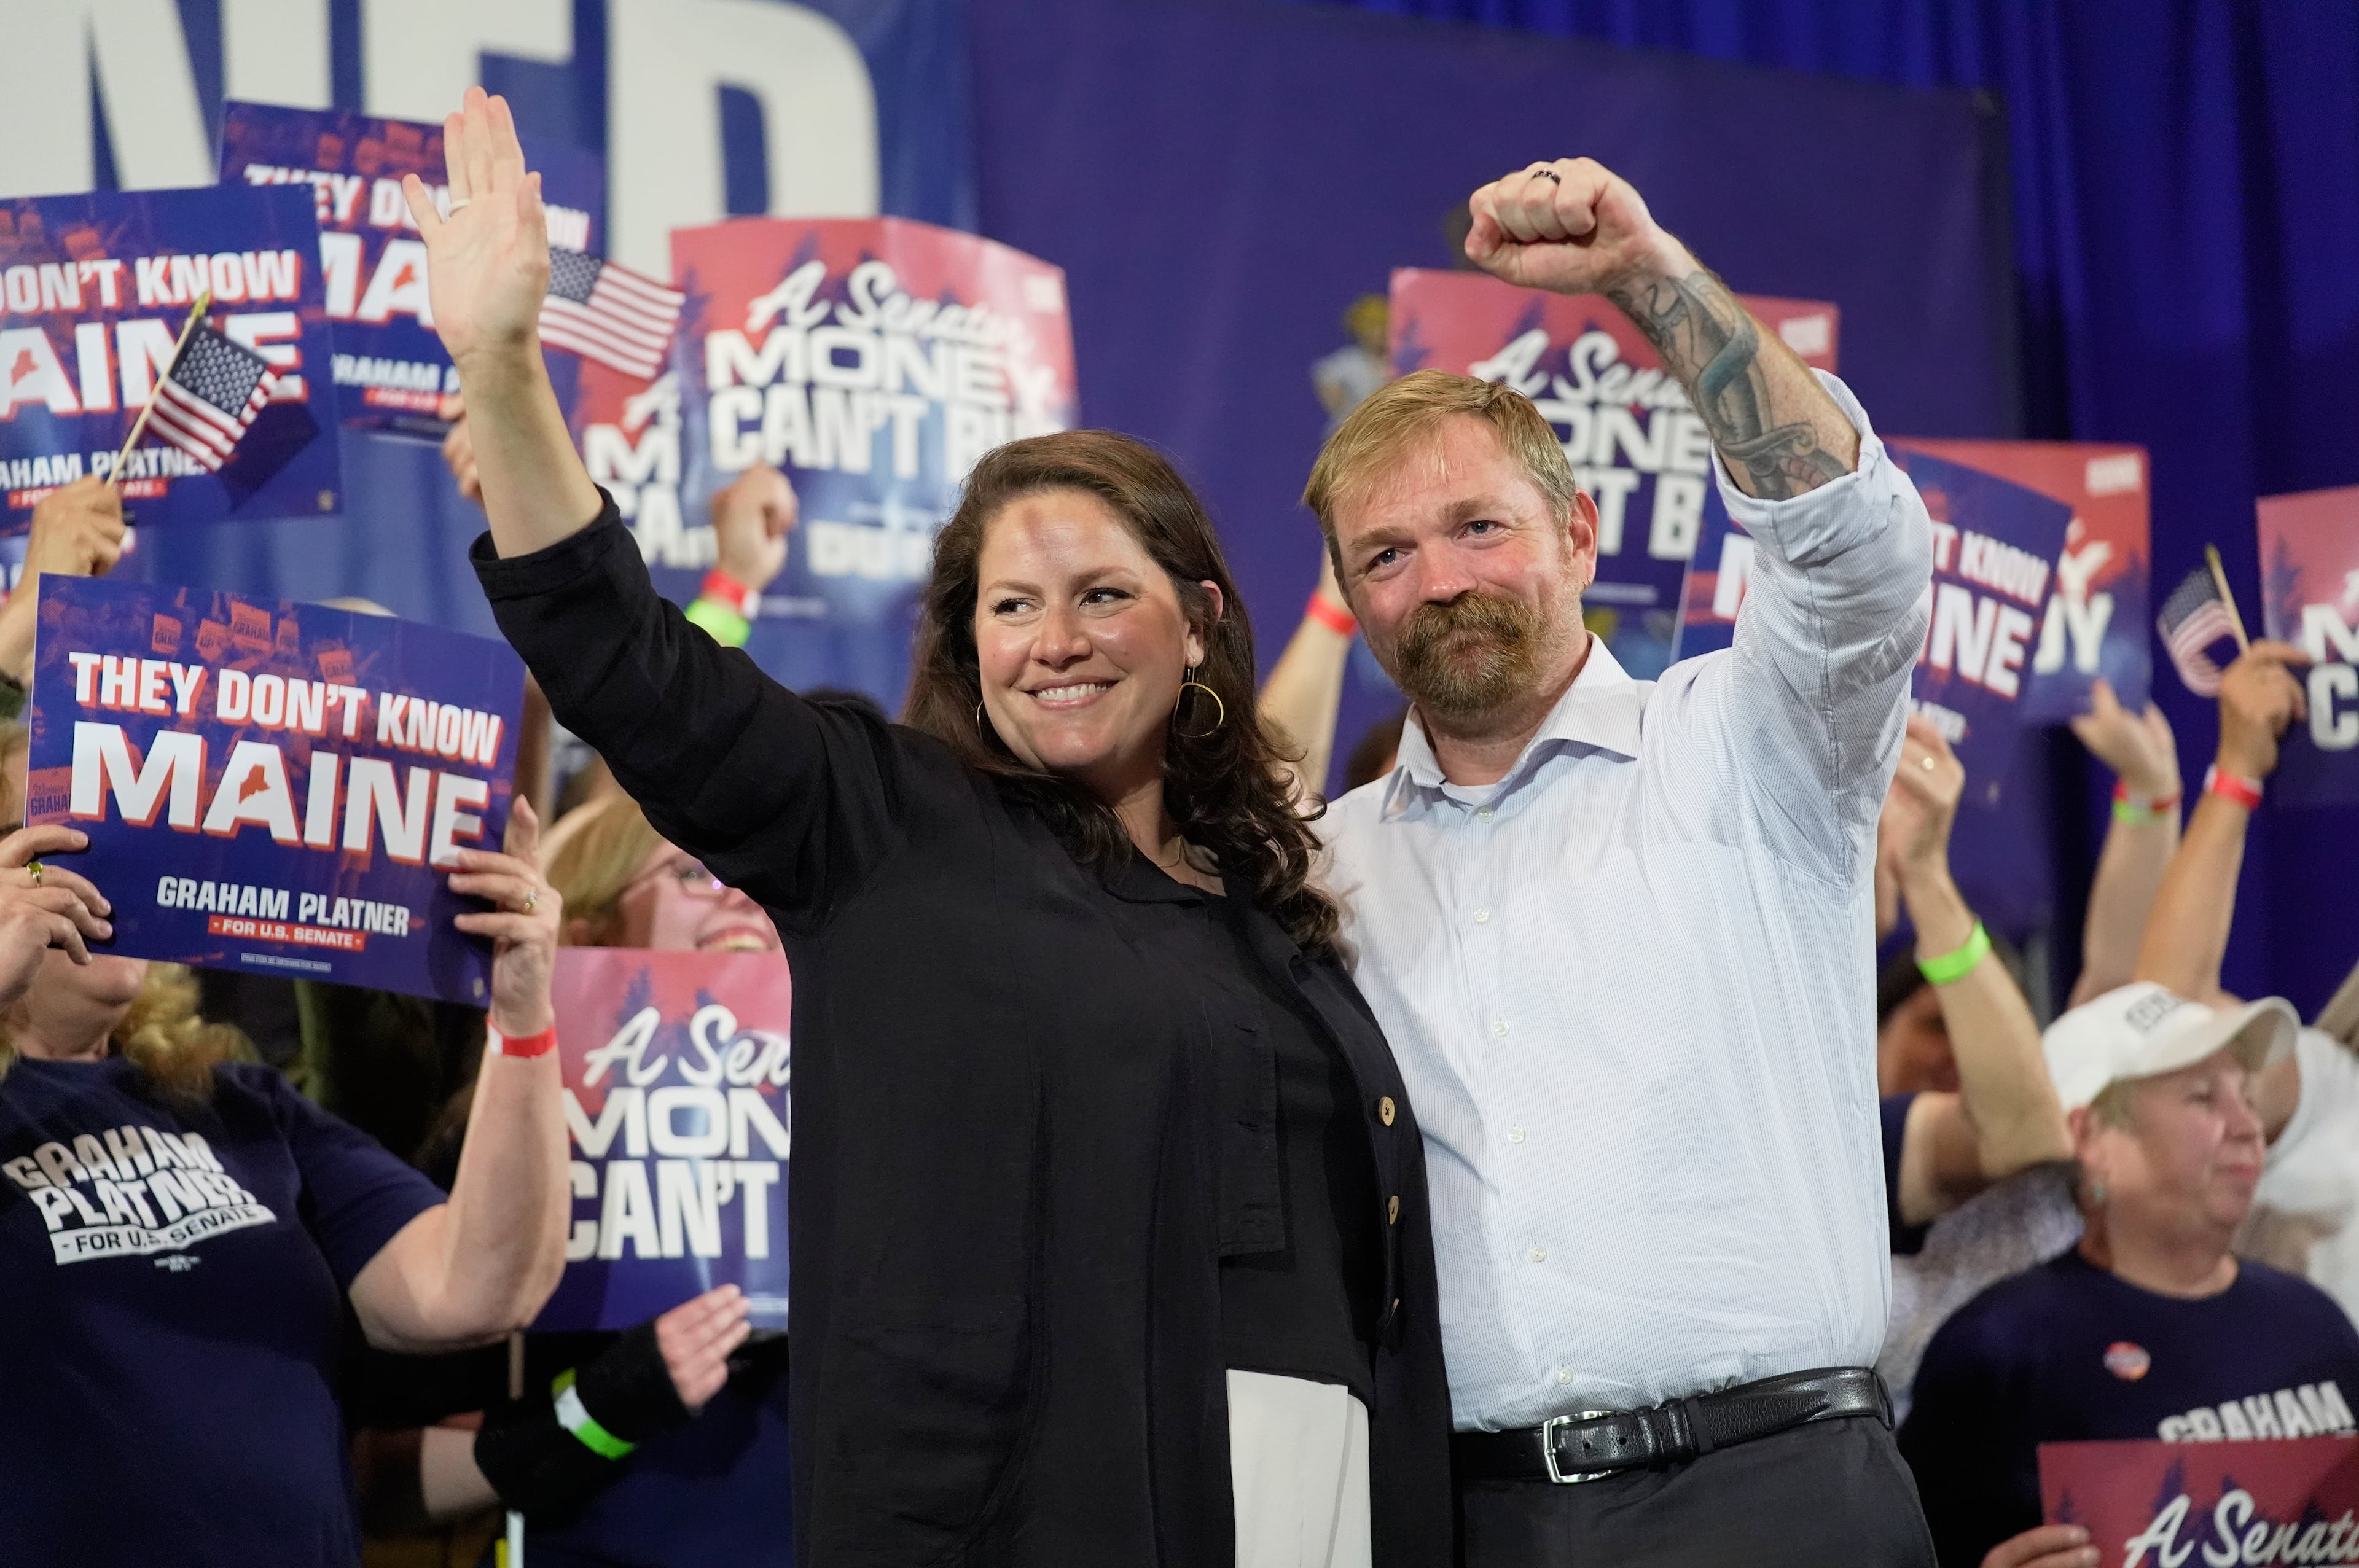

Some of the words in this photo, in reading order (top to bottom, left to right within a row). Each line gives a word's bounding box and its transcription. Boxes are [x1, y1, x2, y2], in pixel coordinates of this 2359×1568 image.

[0, 259, 121, 314] ON'T
[135, 249, 297, 305] KNOW
[746, 260, 832, 333] A
[709, 383, 929, 480] CAN'T
[69, 652, 203, 713] THEY
[217, 668, 367, 736] DON'T
[377, 692, 501, 763] KNOW
[69, 720, 488, 868] MAINE
[157, 876, 290, 920] GRAHAM
[298, 892, 410, 937] PLATNER
[222, 919, 256, 936] FOR
[259, 922, 289, 940] U.S.
[294, 927, 353, 948] SENATE
[584, 1006, 668, 1087] A
[1, 1125, 225, 1188] GRAHAM
[29, 1167, 258, 1234] PLATNER
[76, 1234, 121, 1254] FOR
[167, 1206, 256, 1244] SENATE
[2158, 1380, 2355, 1443] GRAHAM
[2124, 1494, 2194, 1568] A
